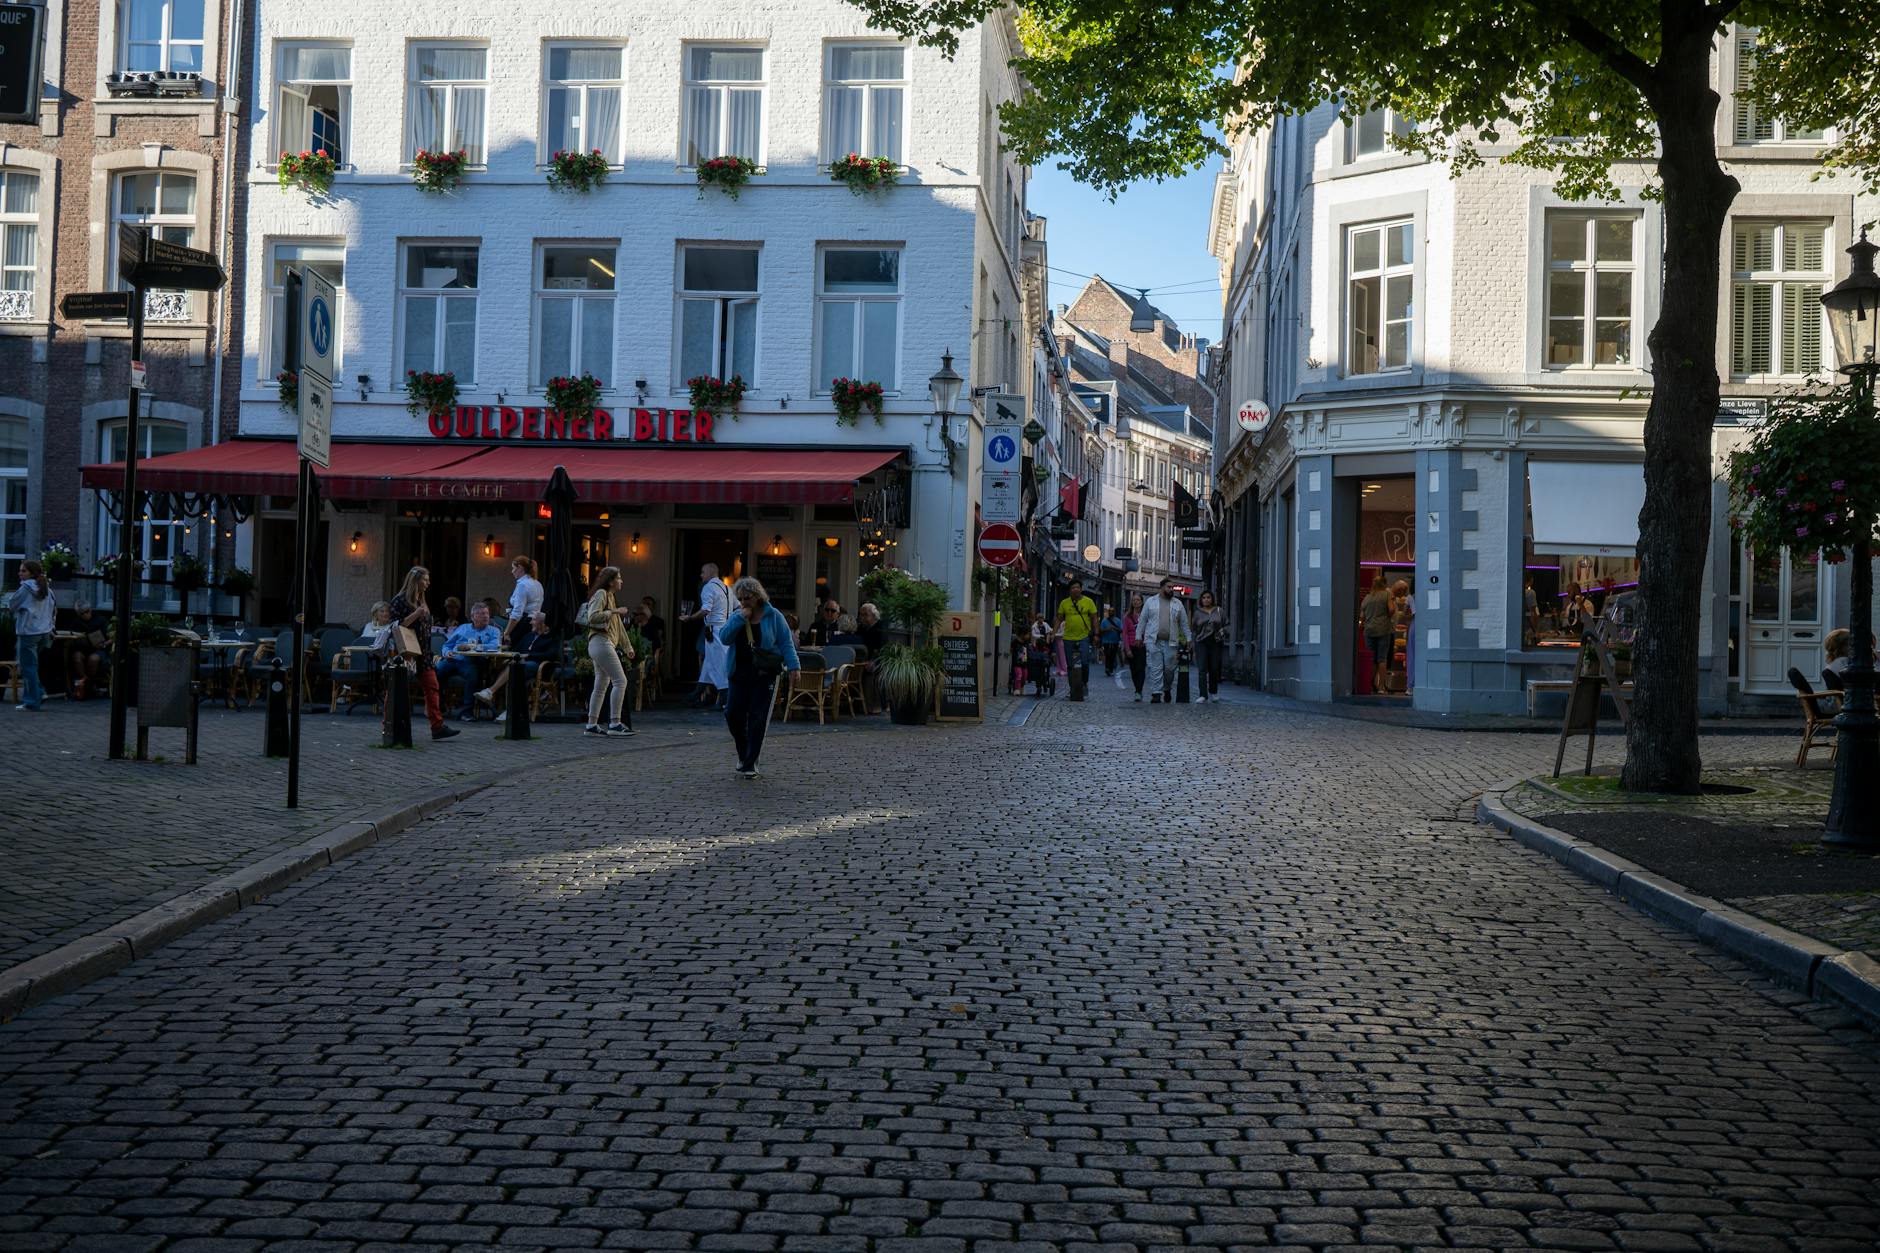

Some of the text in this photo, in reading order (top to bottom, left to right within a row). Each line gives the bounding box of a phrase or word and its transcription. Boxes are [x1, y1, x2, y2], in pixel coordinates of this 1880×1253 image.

[314, 282, 329, 298] ZONE
[428, 405, 716, 442] GULPENER BIER
[414, 483, 433, 497] DE
